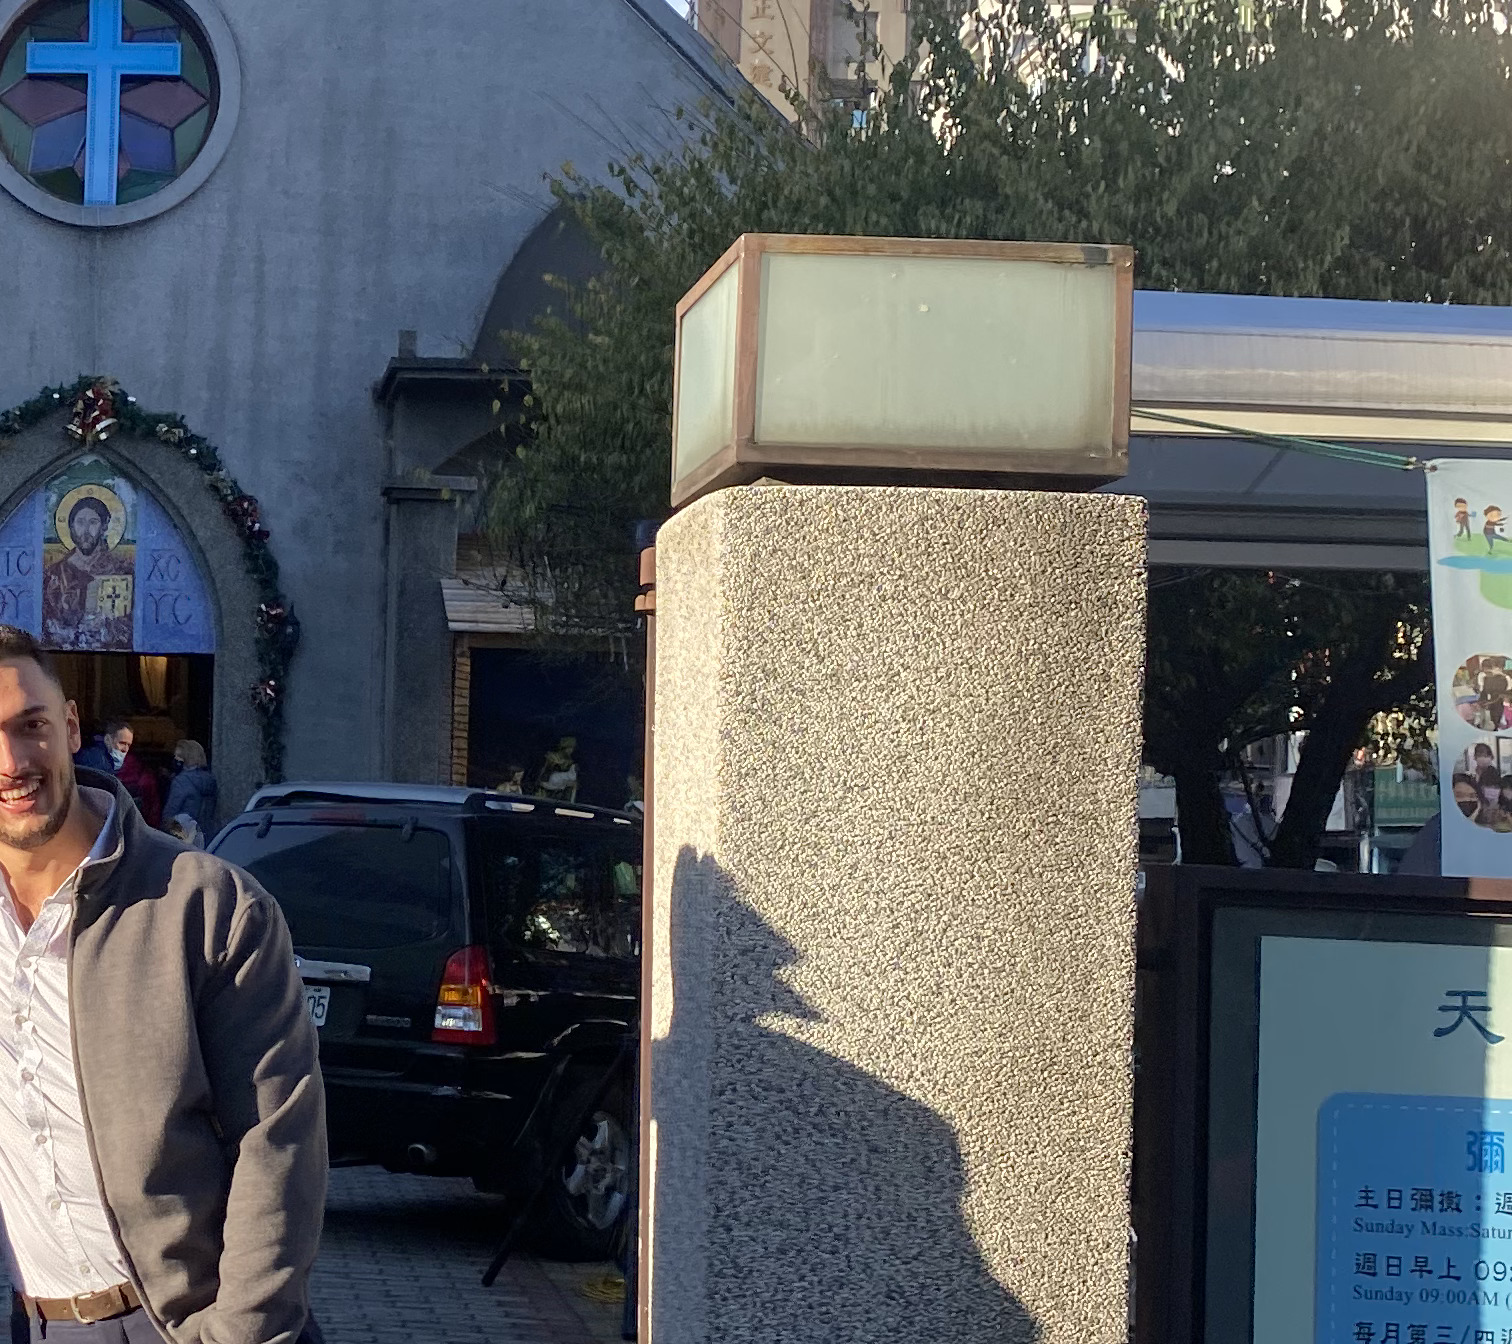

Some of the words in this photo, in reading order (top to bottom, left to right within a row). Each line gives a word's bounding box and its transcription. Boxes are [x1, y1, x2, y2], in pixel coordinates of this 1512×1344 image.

[1433, 990, 1505, 1044] 天
[1465, 1130, 1505, 1173] 彌
[1352, 1217, 1415, 1238] Sunday
[1354, 1252, 1461, 1281] 週日早上
[1352, 1284, 1414, 1305] Sunday
[1420, 1287, 1498, 1307] 09:00AM
